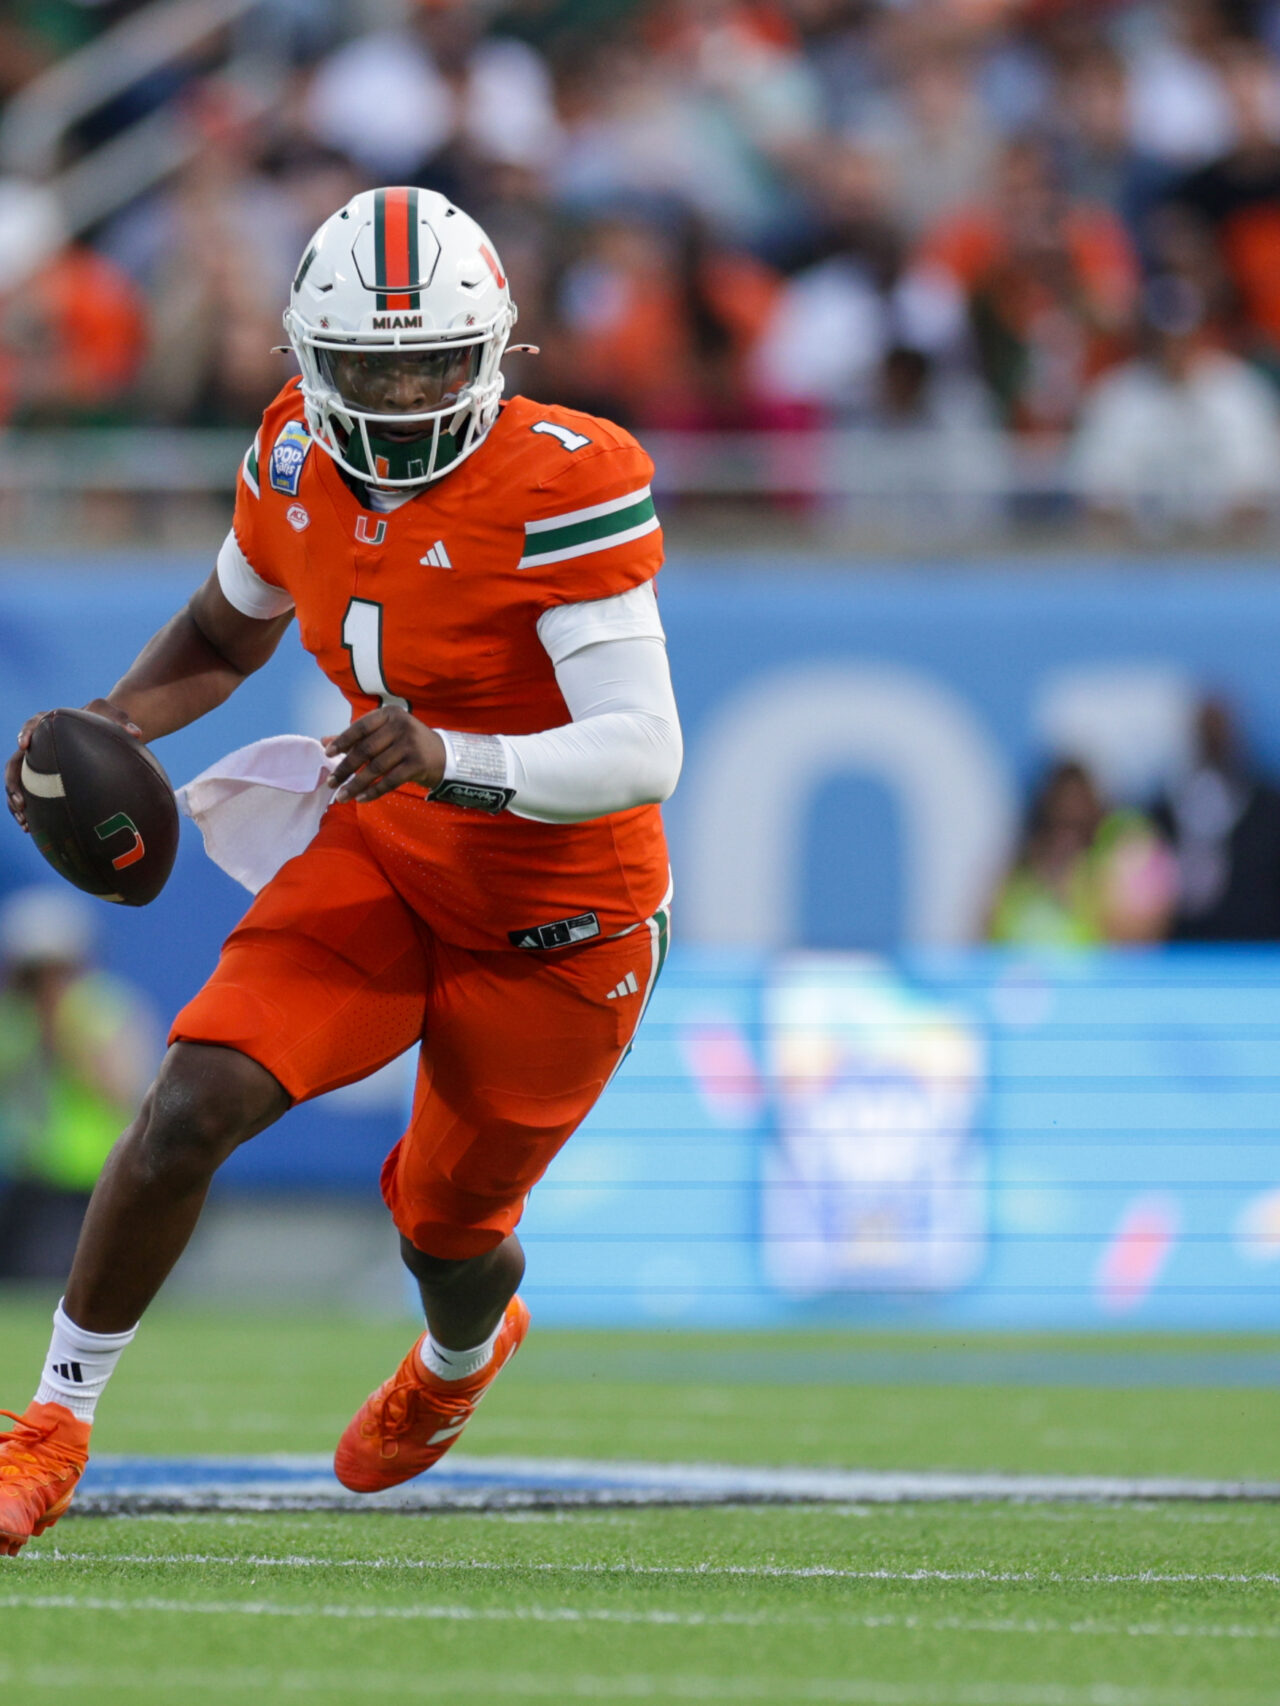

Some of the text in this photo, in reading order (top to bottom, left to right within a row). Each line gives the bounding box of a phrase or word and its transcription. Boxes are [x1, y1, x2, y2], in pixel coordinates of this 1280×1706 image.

[372, 315, 423, 330] MIAMI
[530, 419, 592, 452] 1
[354, 515, 388, 546] U
[341, 595, 413, 714] 1
[94, 811, 146, 871] U
